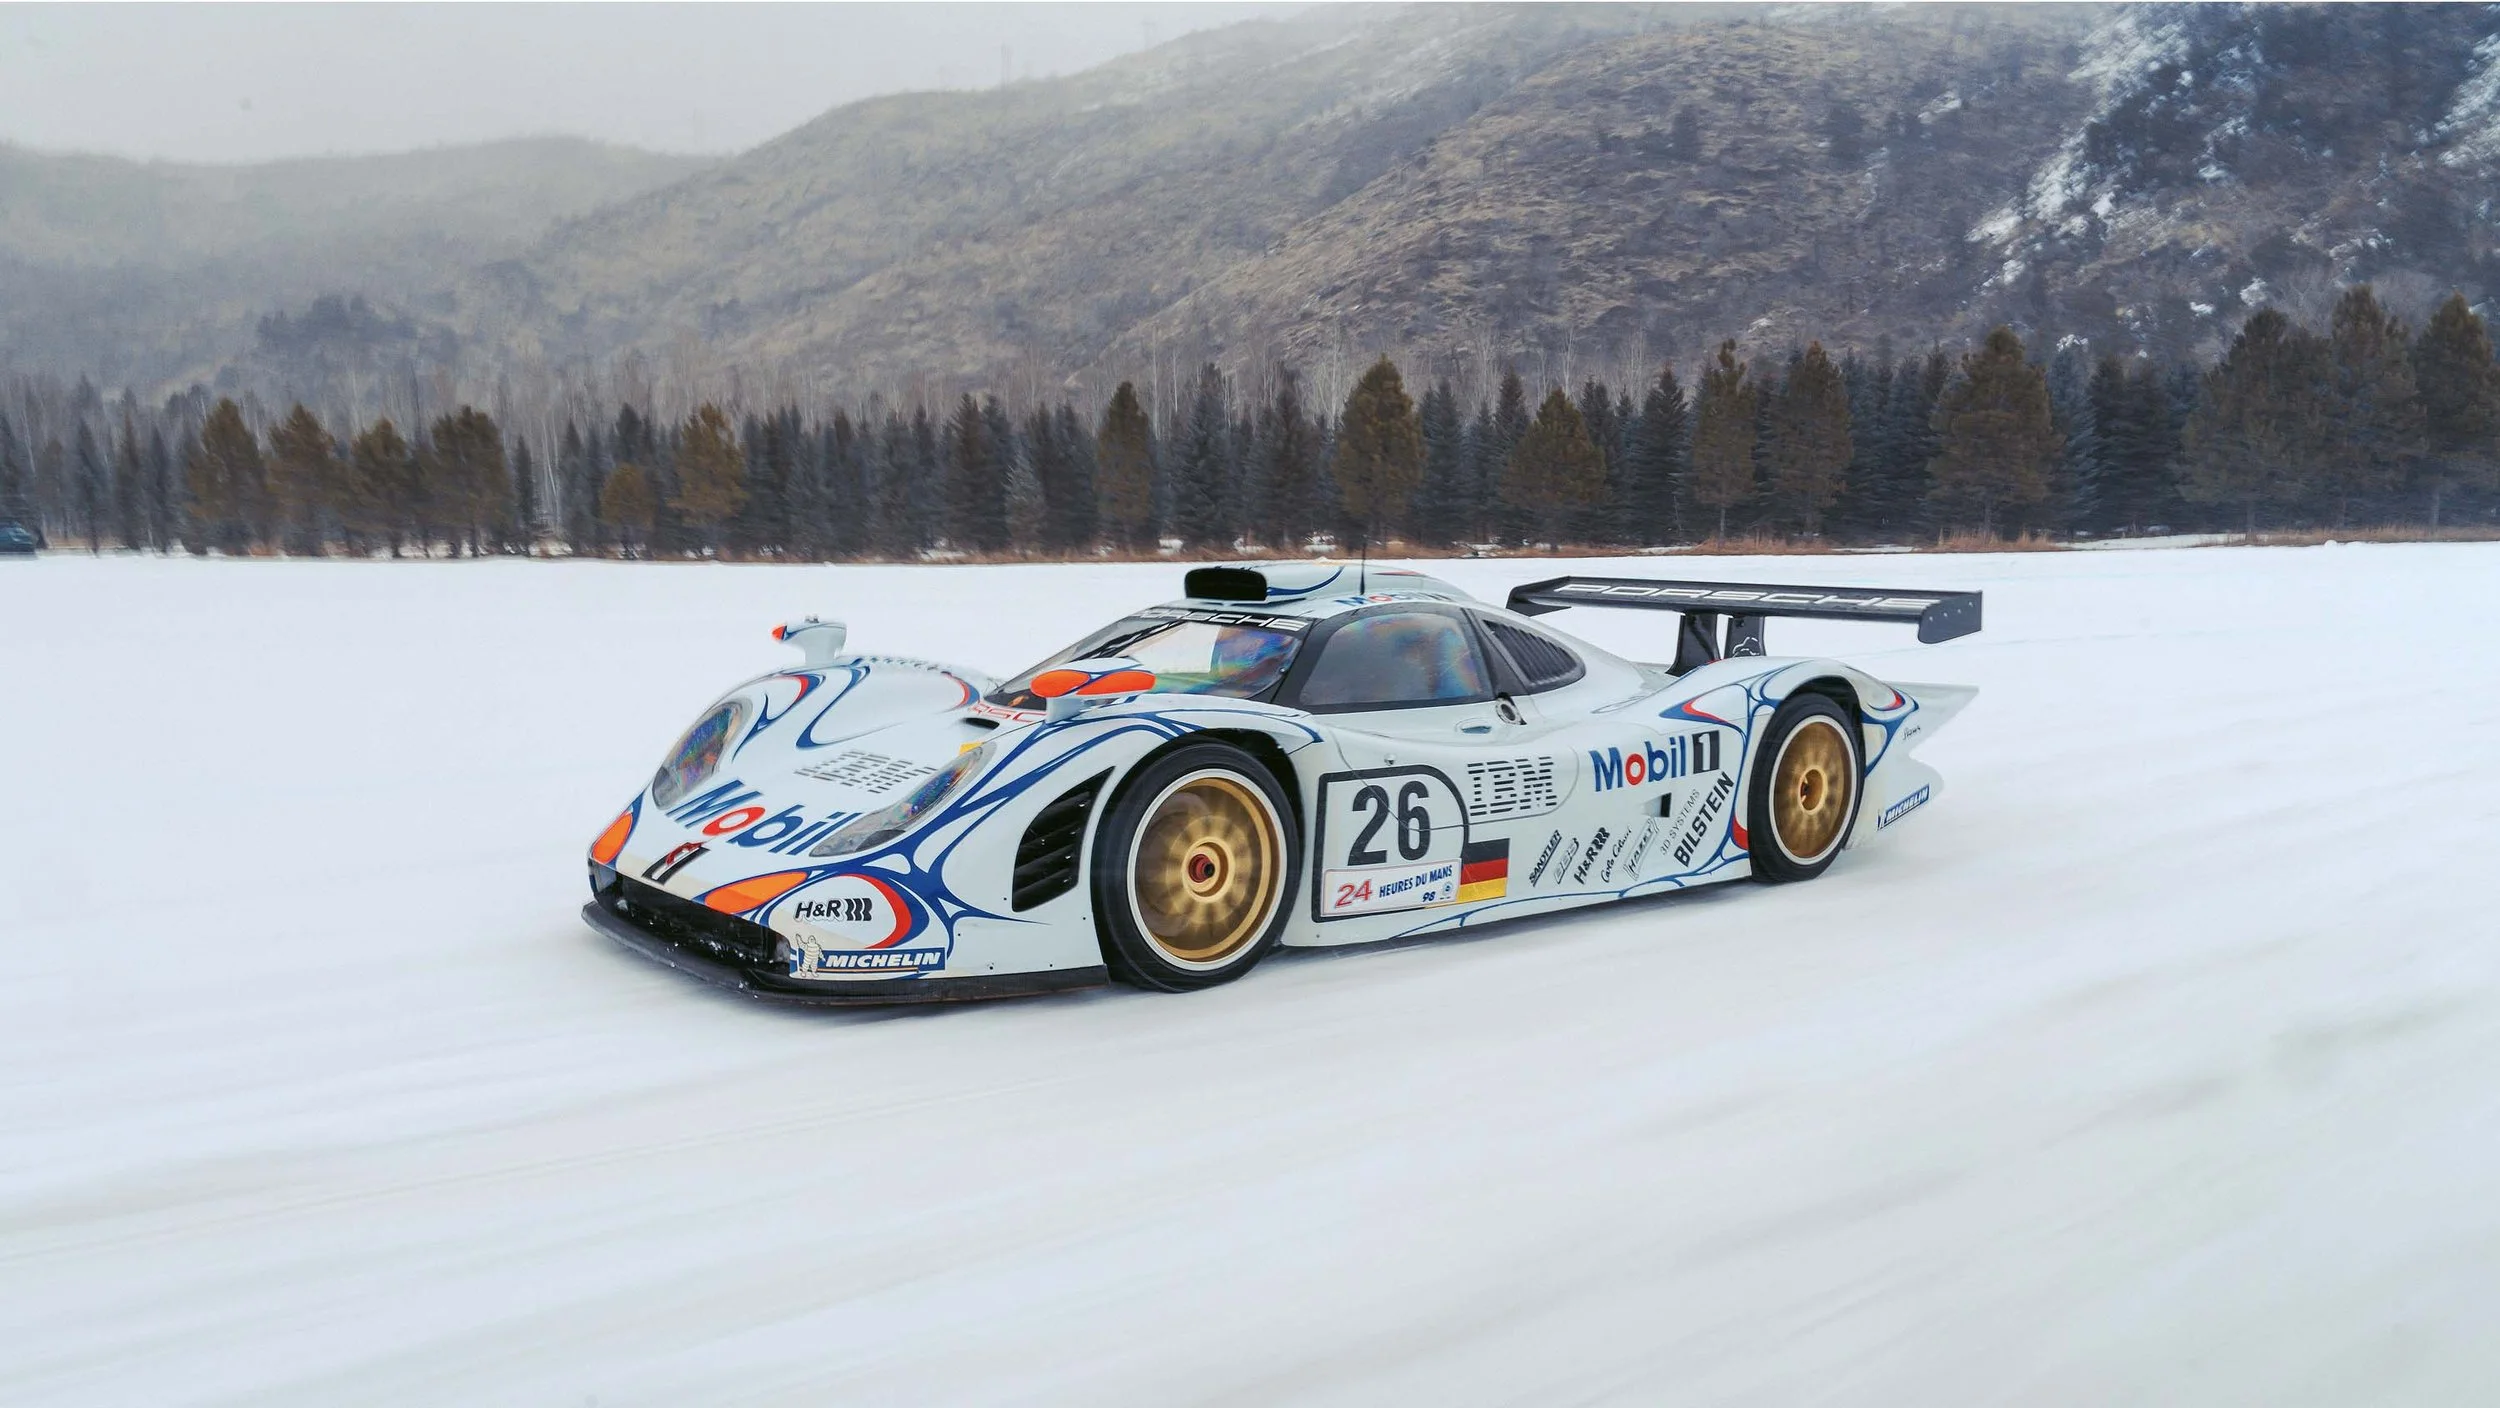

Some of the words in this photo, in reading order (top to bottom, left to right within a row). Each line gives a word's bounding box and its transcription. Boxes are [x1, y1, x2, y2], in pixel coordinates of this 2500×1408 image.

[1553, 584, 1941, 609] PORSCHE
[1467, 756, 1557, 816] IBM
[1588, 736, 1686, 792] Mobil
[1694, 731, 1715, 773] 1
[665, 779, 863, 856] Mobil
[1347, 780, 1430, 866] 26
[1669, 788, 1700, 840] SYSTEMS
[1673, 771, 1734, 867] BILSTEIN
[1886, 787, 1928, 821] MICHELIN
[1528, 829, 1561, 885] SANDTLER
[795, 899, 841, 920] H&R
[1335, 879, 1372, 908] 24
[1379, 877, 1414, 898] HEURES
[1415, 872, 1428, 887] DU
[1429, 865, 1452, 882] MANS
[1422, 891, 1436, 902] 98
[825, 951, 941, 968] MICHELIN
